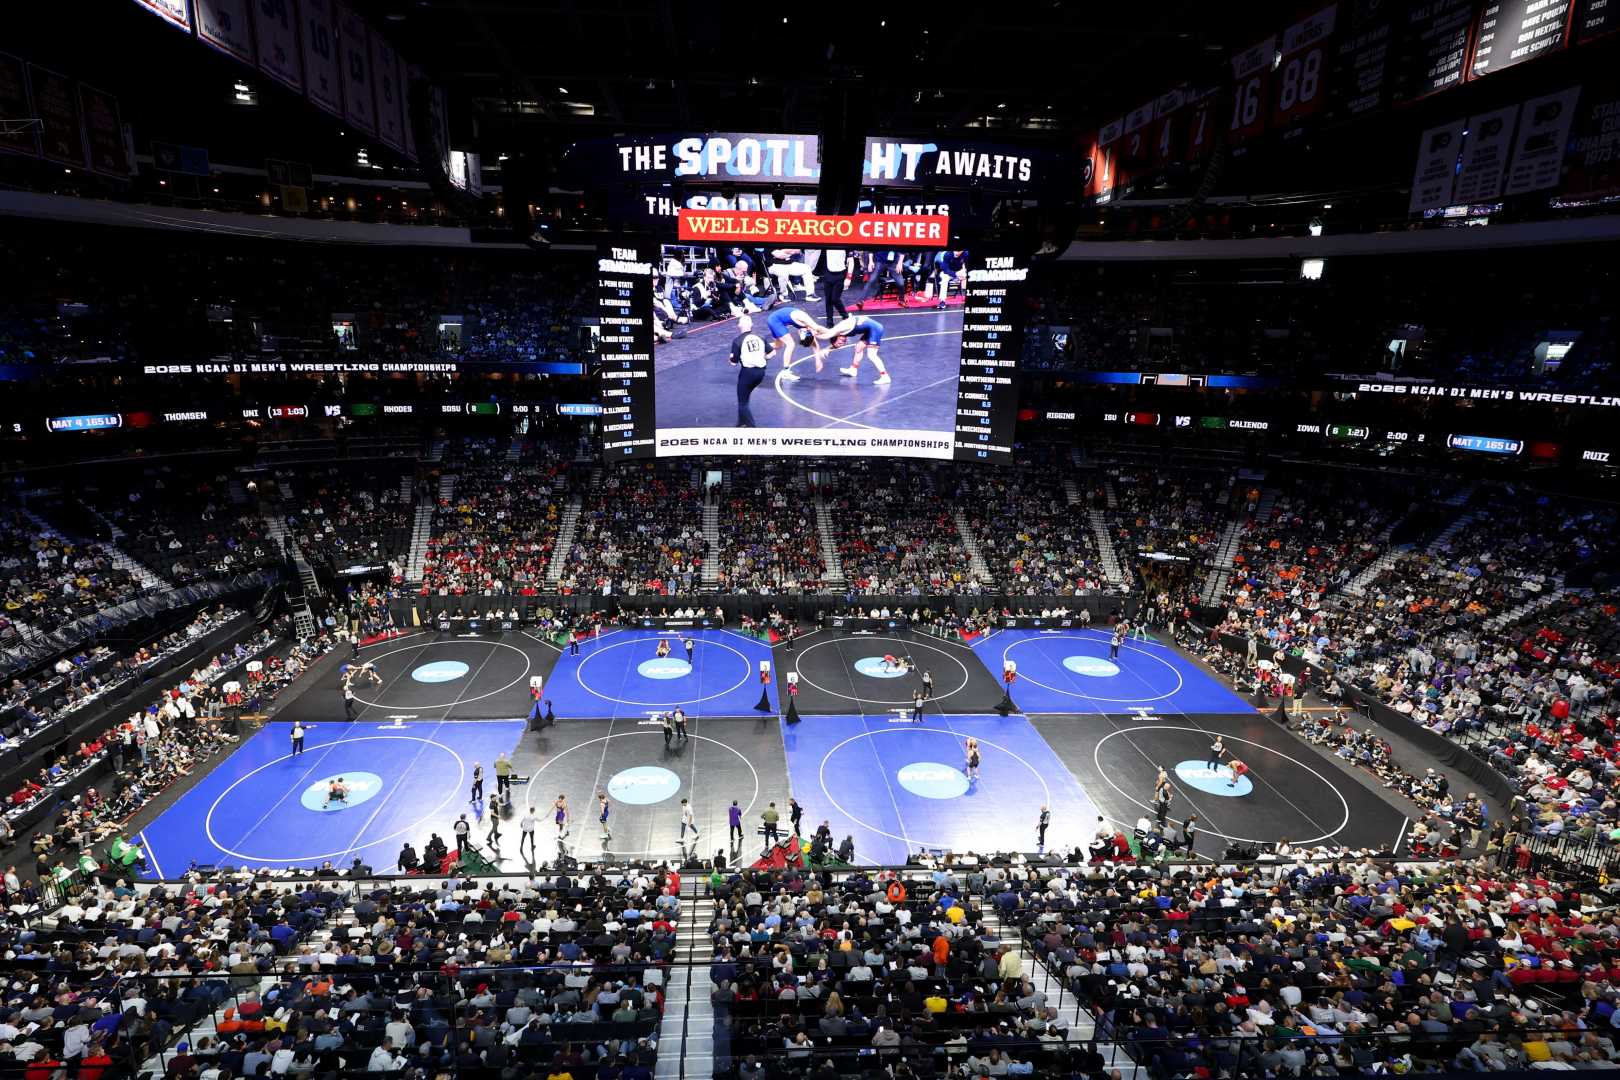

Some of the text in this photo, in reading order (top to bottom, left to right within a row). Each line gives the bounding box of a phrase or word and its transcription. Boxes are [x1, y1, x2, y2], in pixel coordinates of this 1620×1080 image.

[619, 138, 1031, 182] THE SPOTLHT AWAITS
[687, 217, 941, 240] WELLS FARGO CENTER
[612, 248, 637, 260] TEAM
[986, 257, 1014, 268] TEAM
[144, 363, 457, 374] 2025 NCAA DI MEN'S WRESTLING CHAMPIONSHIPS
[1359, 384, 1407, 394] 2025
[1411, 386, 1445, 396] NCAA
[1450, 388, 1466, 398] DI
[1470, 389, 1513, 400] MEN'S
[164, 411, 207, 421] THOMSEN
[243, 409, 259, 418] UNI
[325, 405, 341, 416] VS
[384, 405, 412, 413] RHODES
[52, 420, 72, 429] MAT
[1175, 416, 1191, 427] VS
[1229, 420, 1268, 430] CALIENDO
[1297, 424, 1320, 433] IOWA
[1387, 432, 1408, 441] 2:00
[703, 438, 728, 446] NCAA
[733, 438, 743, 446] DI
[748, 438, 777, 446] MEN'S
[781, 438, 867, 447] WRESTLING
[870, 439, 949, 450] CHAMPIONSHIPS
[1453, 438, 1473, 446] MAT
[1476, 440, 1483, 448] 7
[1583, 451, 1610, 462] RUIZ
